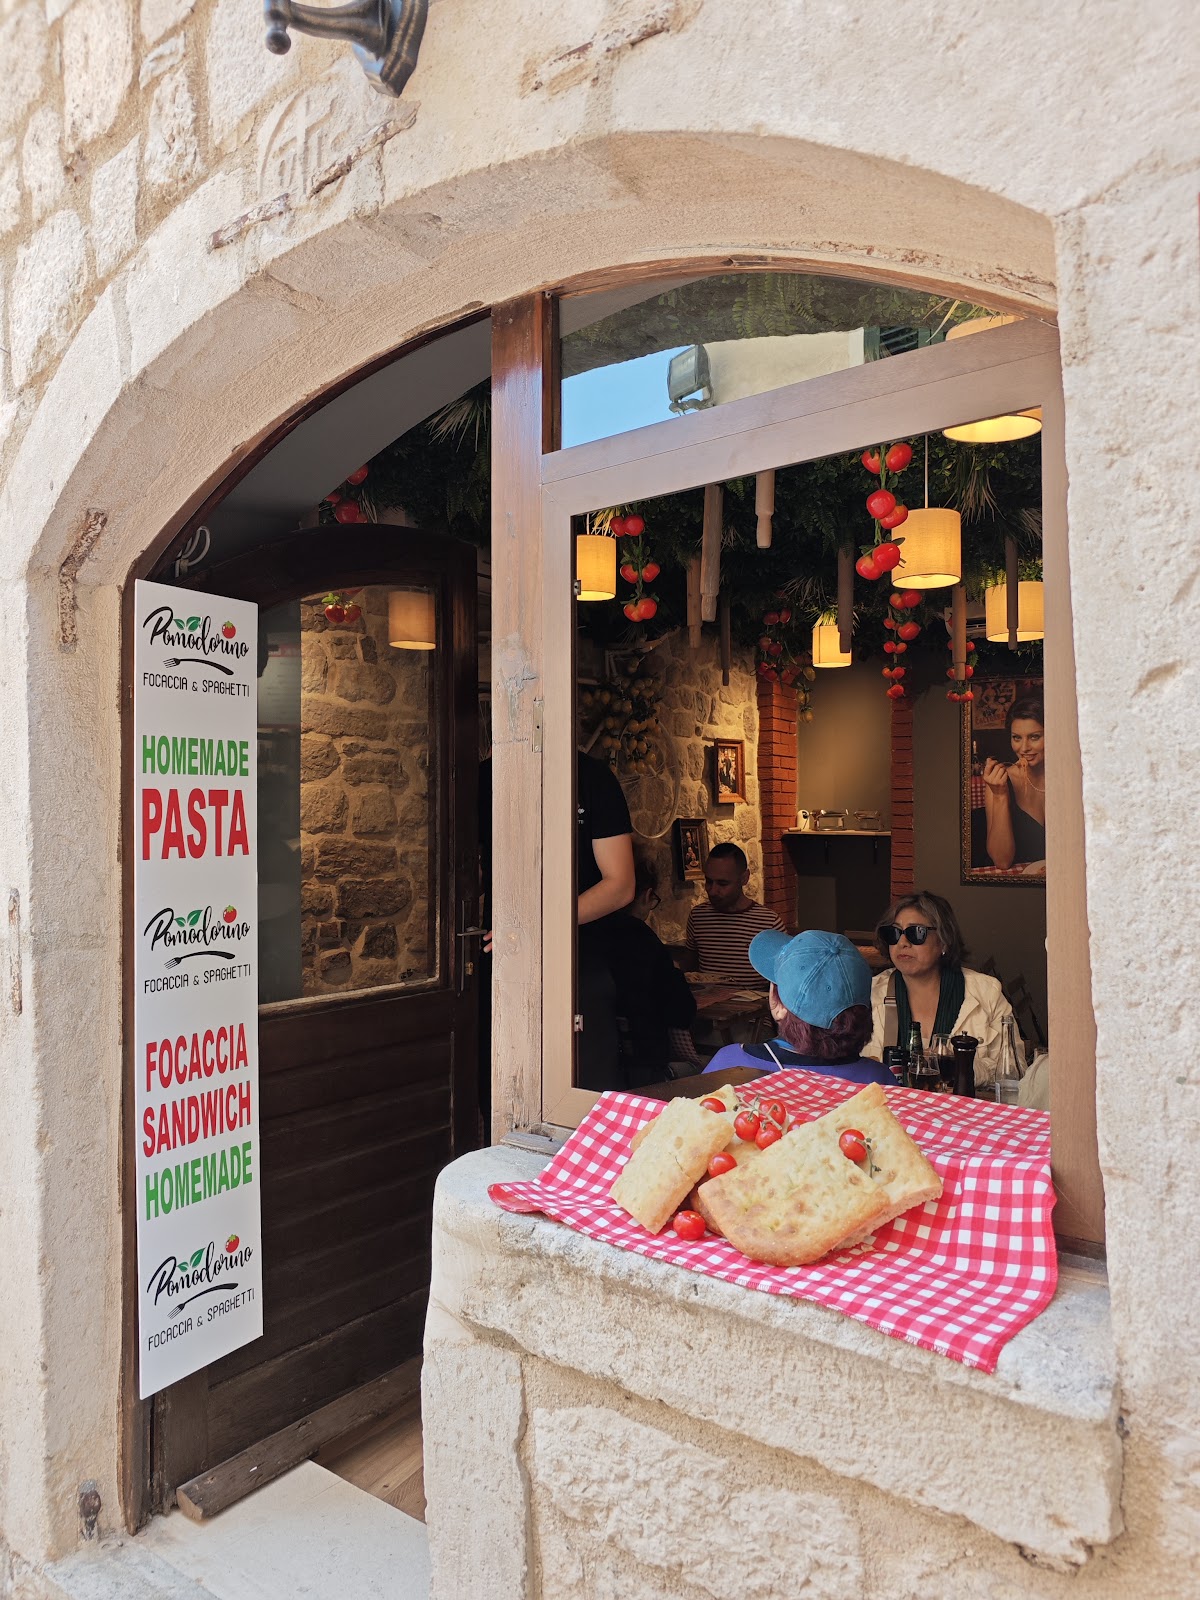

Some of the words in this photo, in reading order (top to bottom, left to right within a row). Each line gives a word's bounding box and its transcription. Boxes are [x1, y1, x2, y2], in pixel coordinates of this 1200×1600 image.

[143, 606, 249, 659] Pomodorino
[143, 673, 188, 691] FOCACCIA
[192, 682, 198, 692] &
[202, 680, 250, 697] SPAGHETTI
[142, 735, 249, 776] HOMEMADE
[142, 788, 249, 860] PASTA
[144, 906, 251, 951] Pomodorino
[144, 974, 189, 994] FOCACCIA
[193, 975, 199, 986] &
[203, 964, 251, 984] SPAGHETTI
[146, 1023, 248, 1092] FOCACCIA
[143, 1080, 251, 1158] SANDWICH
[145, 1141, 253, 1221] HOMEMADE
[147, 1241, 253, 1306] Pomodorino
[148, 1318, 193, 1351] FOCACCIA
[196, 1316, 203, 1327] &
[207, 1288, 255, 1322] SPAGHETTI
